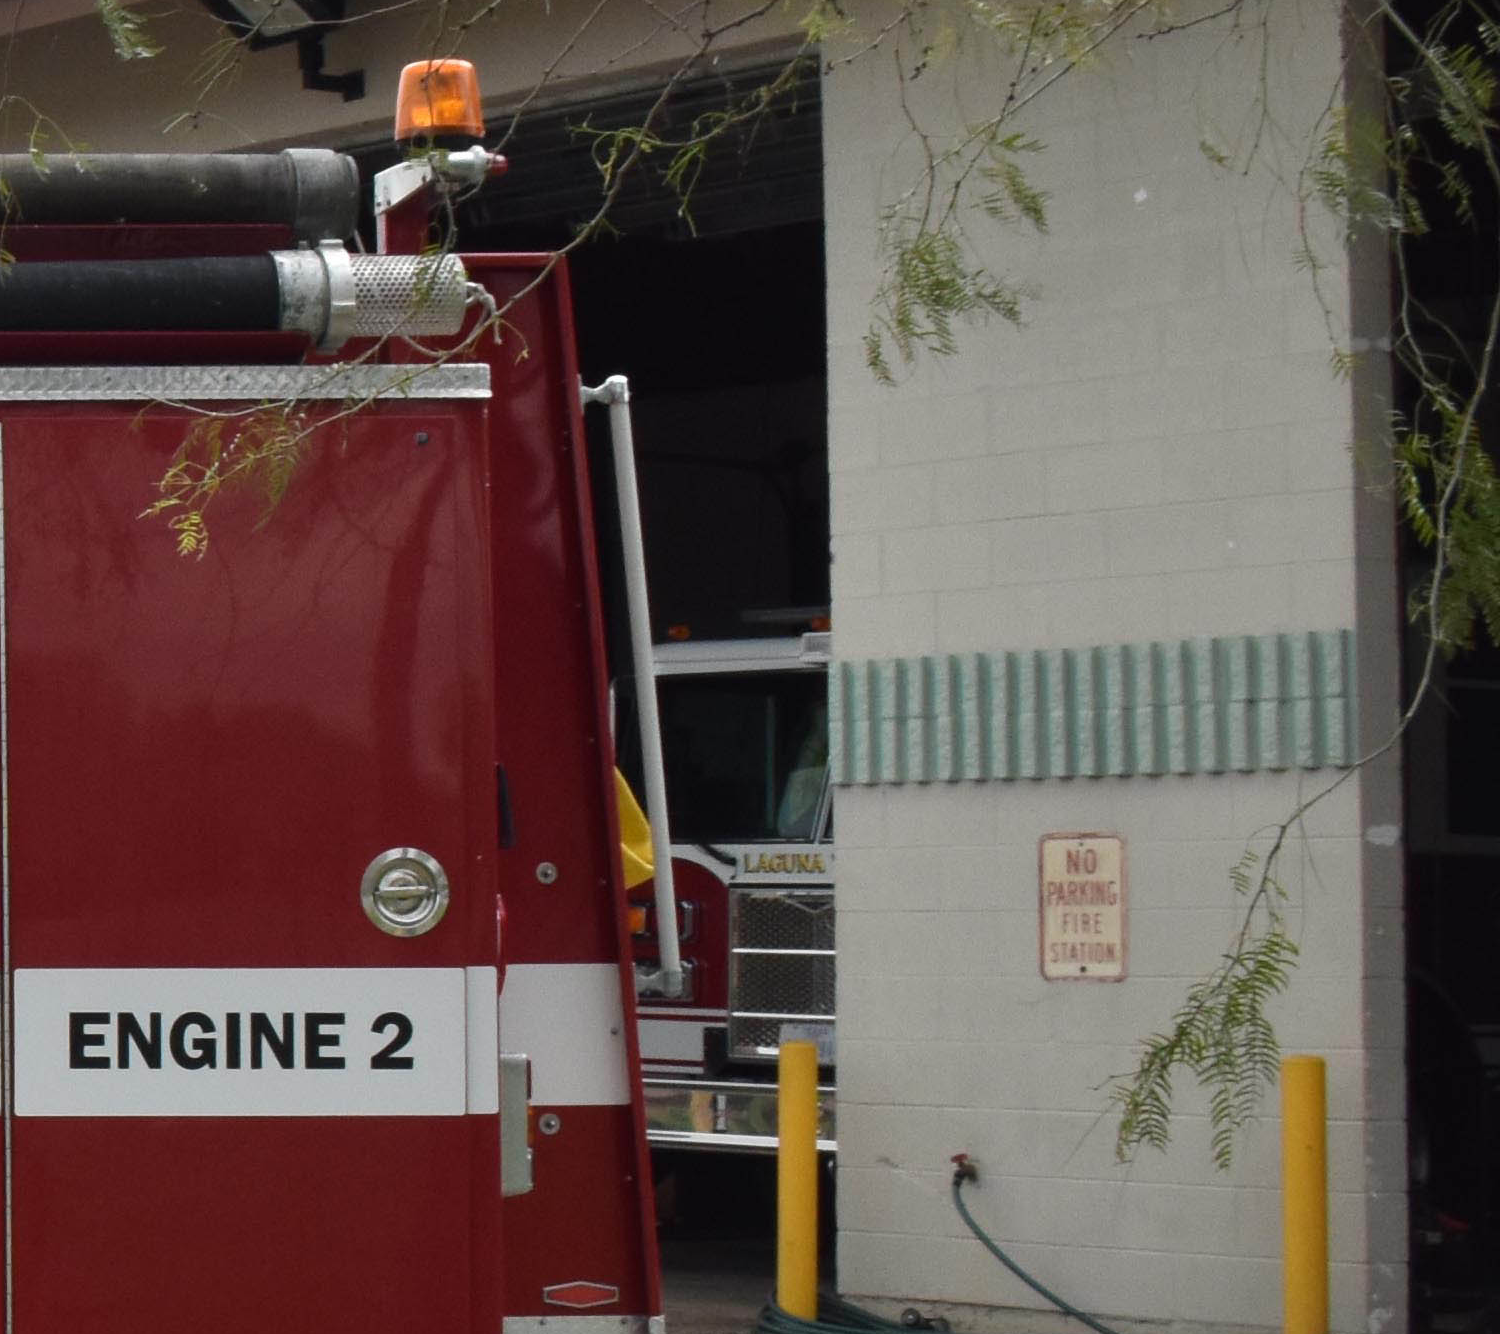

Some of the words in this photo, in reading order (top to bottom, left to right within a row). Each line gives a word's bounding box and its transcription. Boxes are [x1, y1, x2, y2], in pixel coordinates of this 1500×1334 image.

[744, 852, 826, 873] LAGUNA
[1066, 849, 1097, 874] NO
[1047, 880, 1117, 906] PARKING
[1062, 912, 1103, 934] FIRE
[1050, 942, 1117, 963] STATION
[68, 1011, 346, 1071] ENGINE
[369, 1011, 415, 1071] 2
